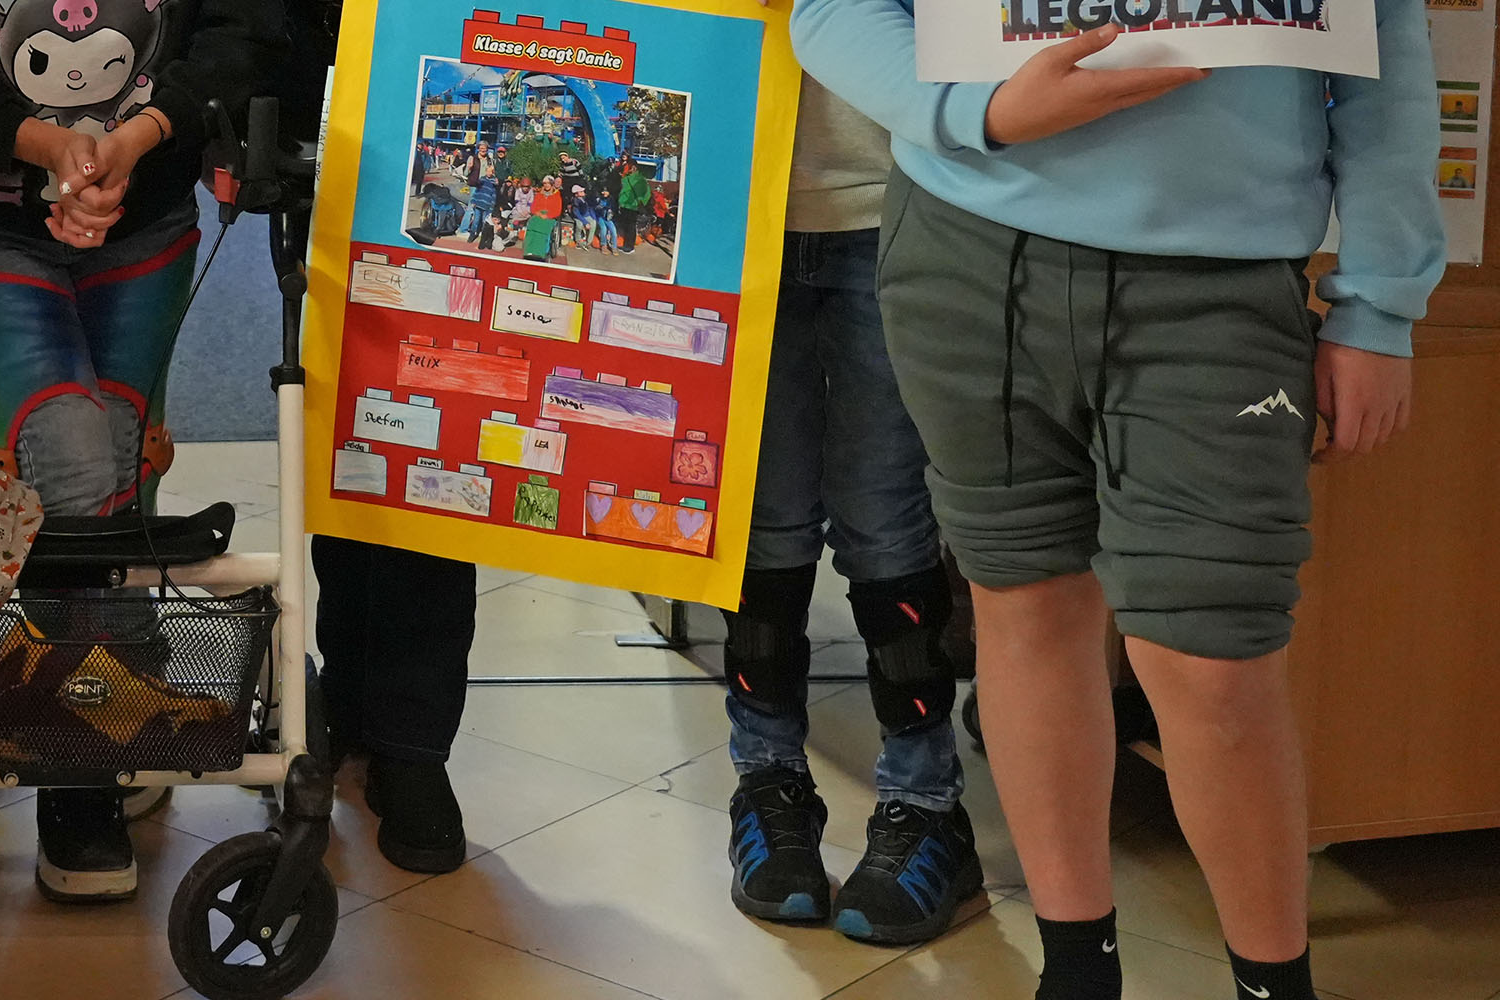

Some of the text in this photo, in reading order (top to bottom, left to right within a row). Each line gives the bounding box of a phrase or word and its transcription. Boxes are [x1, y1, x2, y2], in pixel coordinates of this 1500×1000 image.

[474, 35, 622, 70] Klasse 4 sagt Danke
[69, 684, 102, 694] POINT
